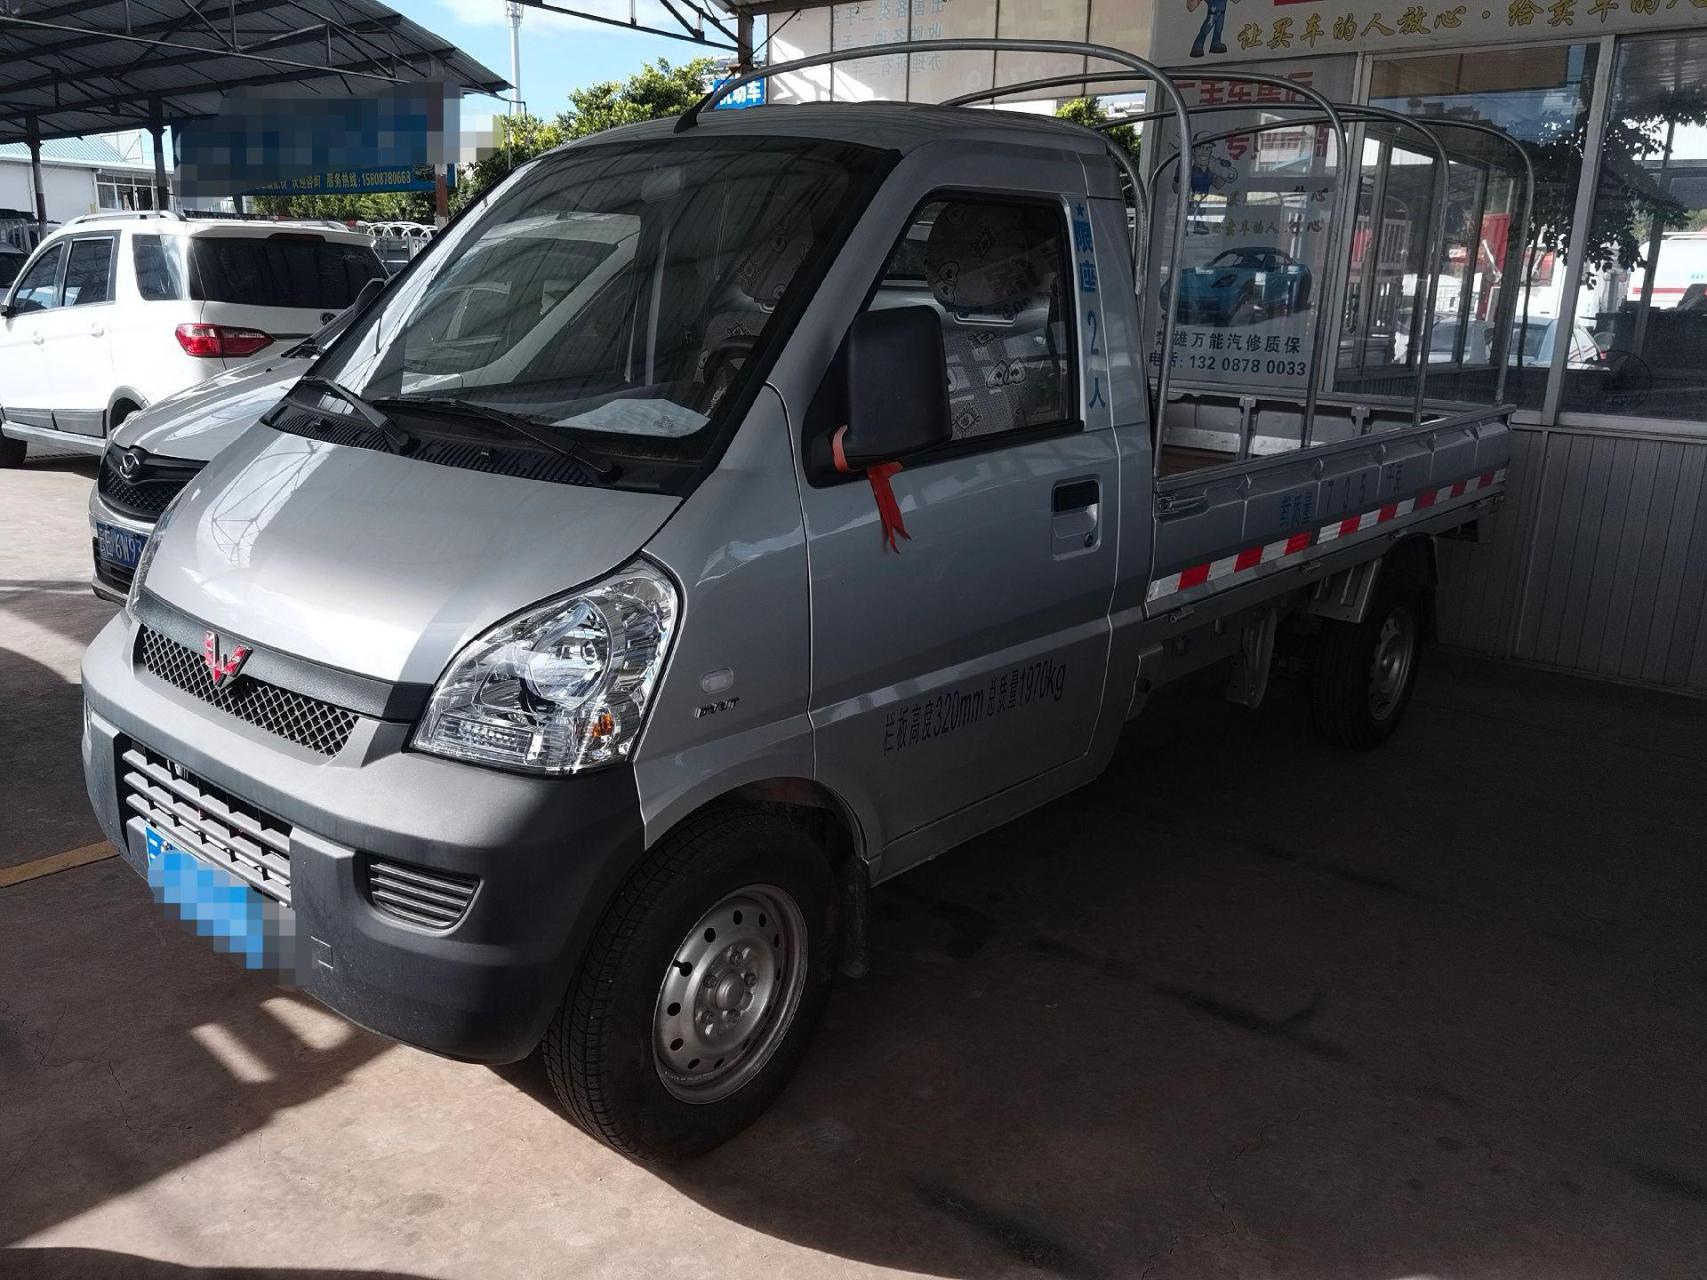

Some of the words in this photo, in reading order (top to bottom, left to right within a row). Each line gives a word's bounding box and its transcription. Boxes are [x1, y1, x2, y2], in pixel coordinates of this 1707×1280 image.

[720, 80, 762, 105] 动车
[1189, 354, 1216, 371] 132
[1221, 357, 1261, 374] 0878
[1266, 359, 1307, 377] 0033
